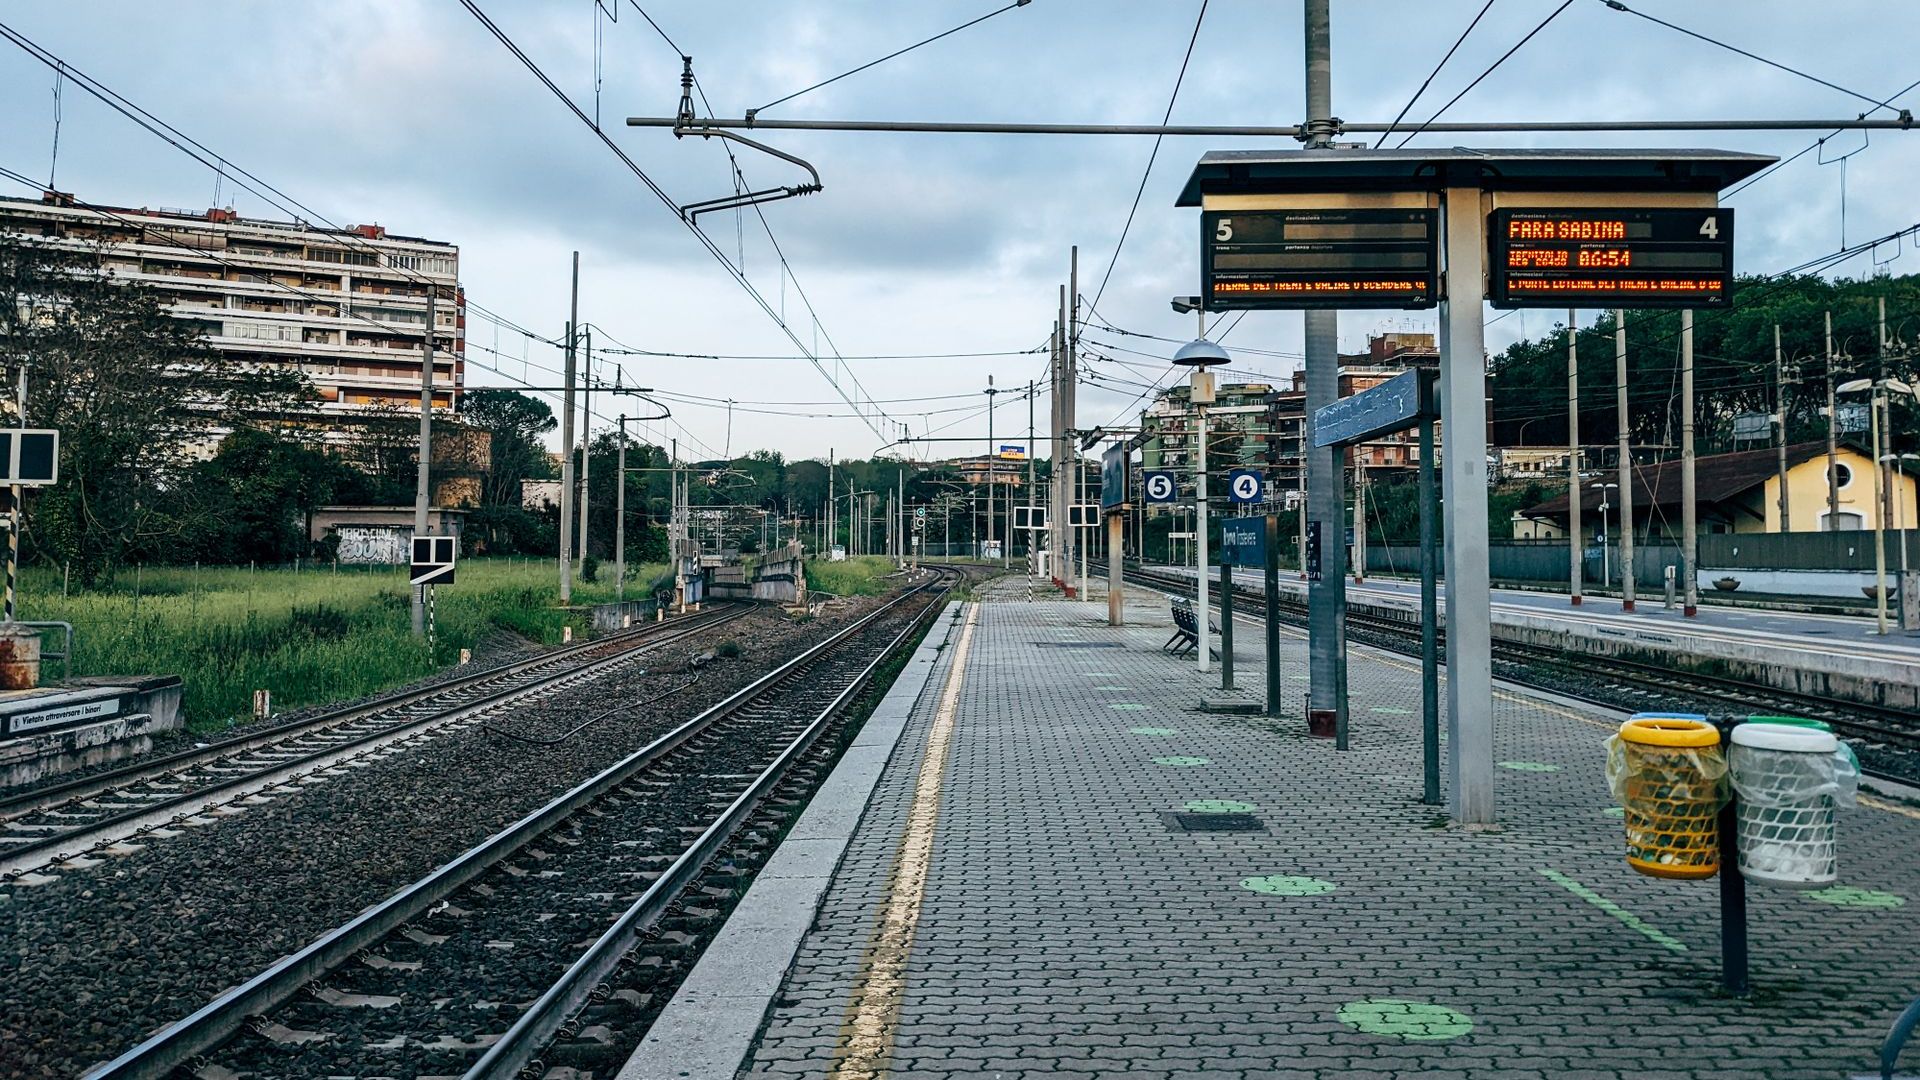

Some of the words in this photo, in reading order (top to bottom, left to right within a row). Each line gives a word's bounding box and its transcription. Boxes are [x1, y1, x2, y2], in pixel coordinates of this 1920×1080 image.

[1216, 219, 1233, 241] 5
[1510, 221, 1554, 238] FARA
[1559, 221, 1624, 238] SABINA
[1700, 216, 1718, 239] 4
[1579, 250, 1629, 266] 06:54
[1153, 478, 1167, 496] 5
[1239, 479, 1252, 494] 4
[22, 715, 44, 725] Vietato
[45, 709, 81, 721] attraversare
[85, 704, 102, 714] binari
